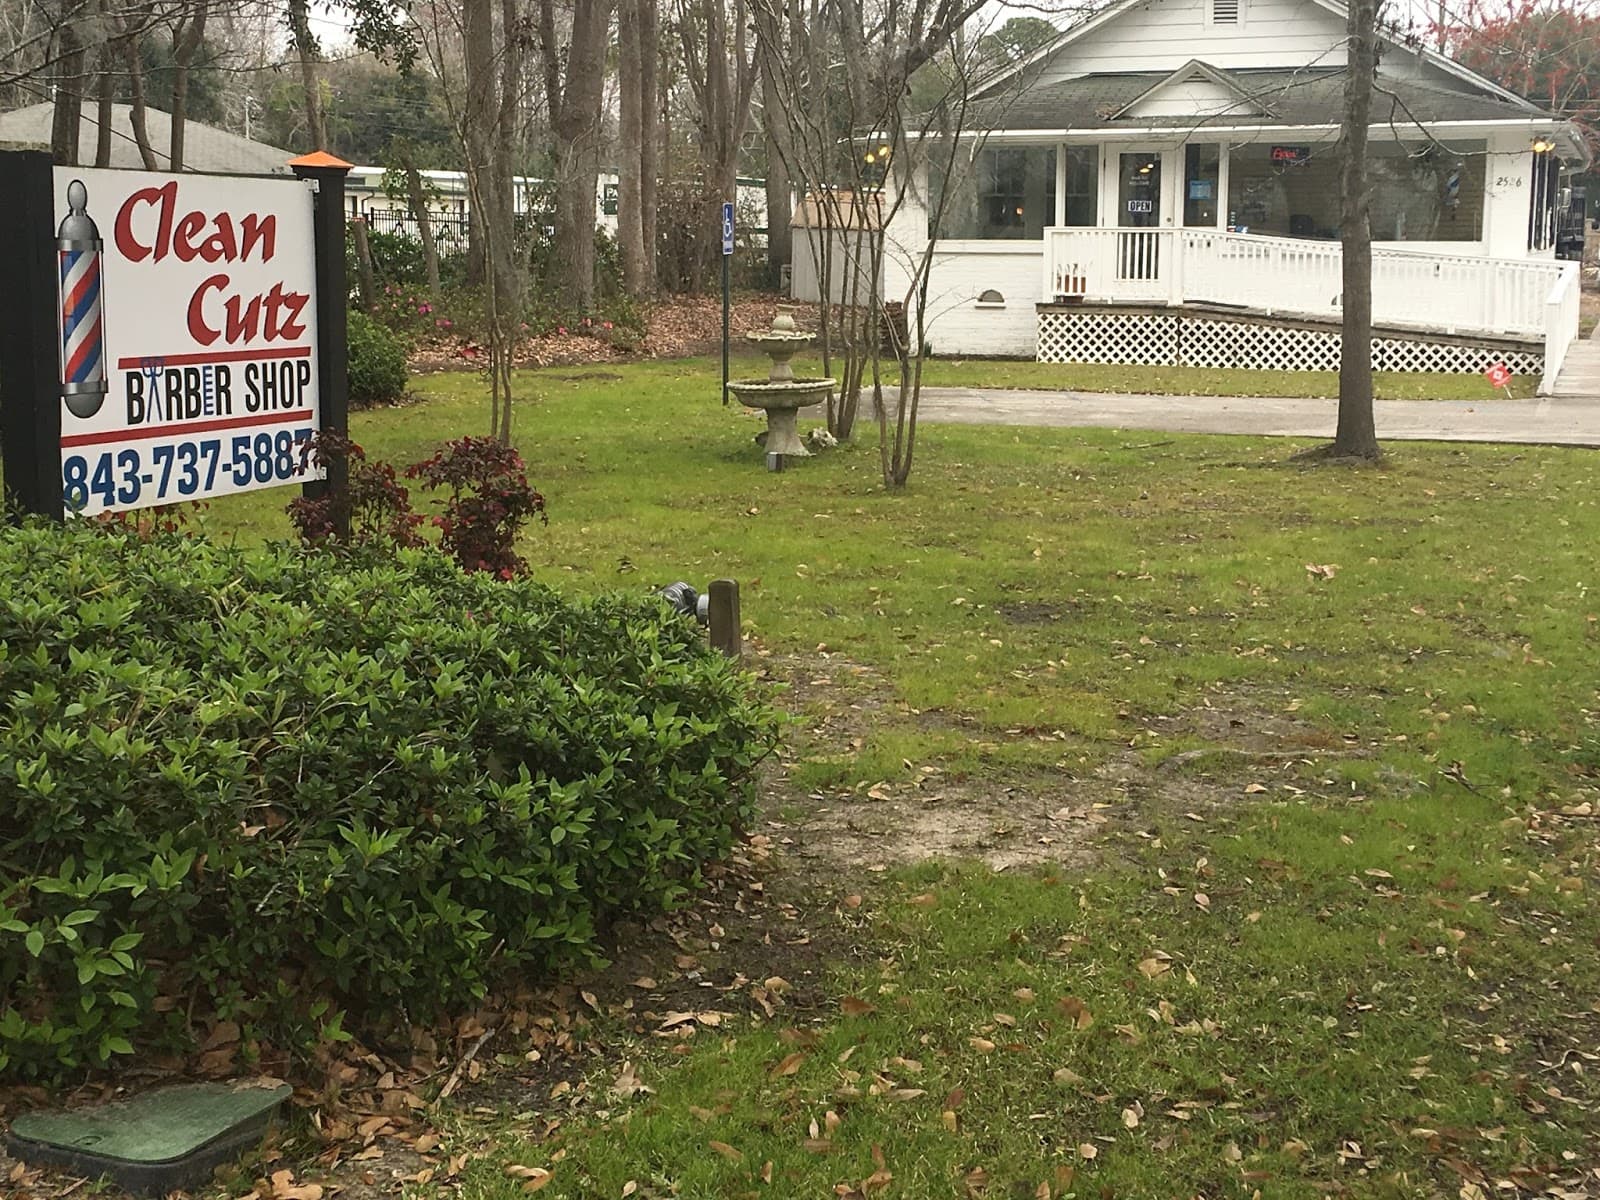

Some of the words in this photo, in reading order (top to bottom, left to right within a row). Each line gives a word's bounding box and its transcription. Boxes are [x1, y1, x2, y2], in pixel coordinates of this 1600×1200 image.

[114, 181, 277, 264] Clean
[1130, 201, 1150, 211] OPEN
[187, 274, 310, 346] Cutz
[126, 359, 232, 425] BARBER
[245, 360, 311, 412] SHOP
